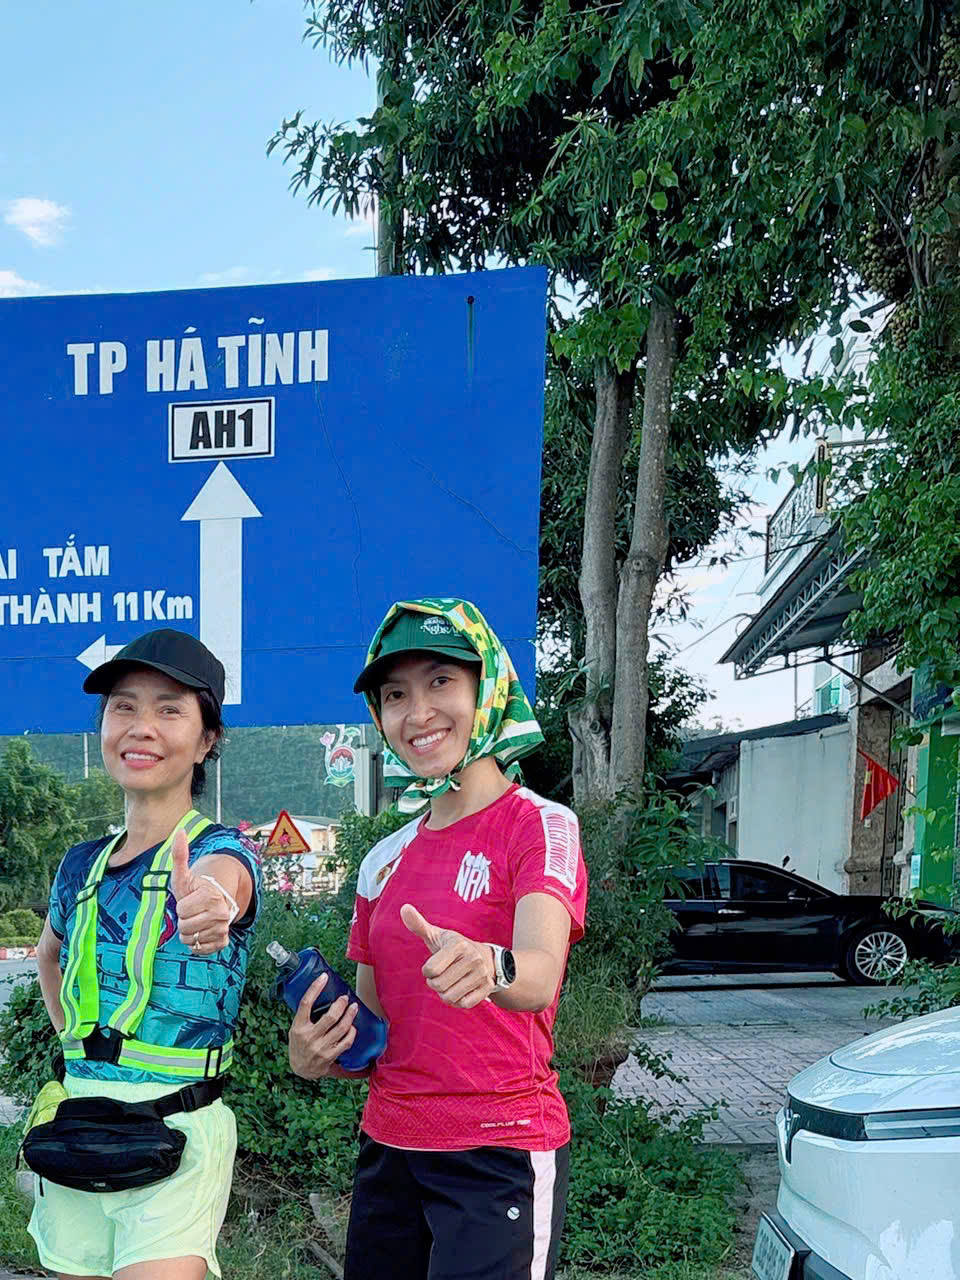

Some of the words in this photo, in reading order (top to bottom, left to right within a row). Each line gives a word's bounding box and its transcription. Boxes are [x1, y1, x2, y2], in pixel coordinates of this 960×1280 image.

[66, 341, 128, 396] TP
[217, 316, 329, 389] TĨNH
[189, 408, 253, 450] AH1
[43, 533, 109, 578] TẮM
[113, 591, 138, 622] 11
[143, 589, 193, 621] Km
